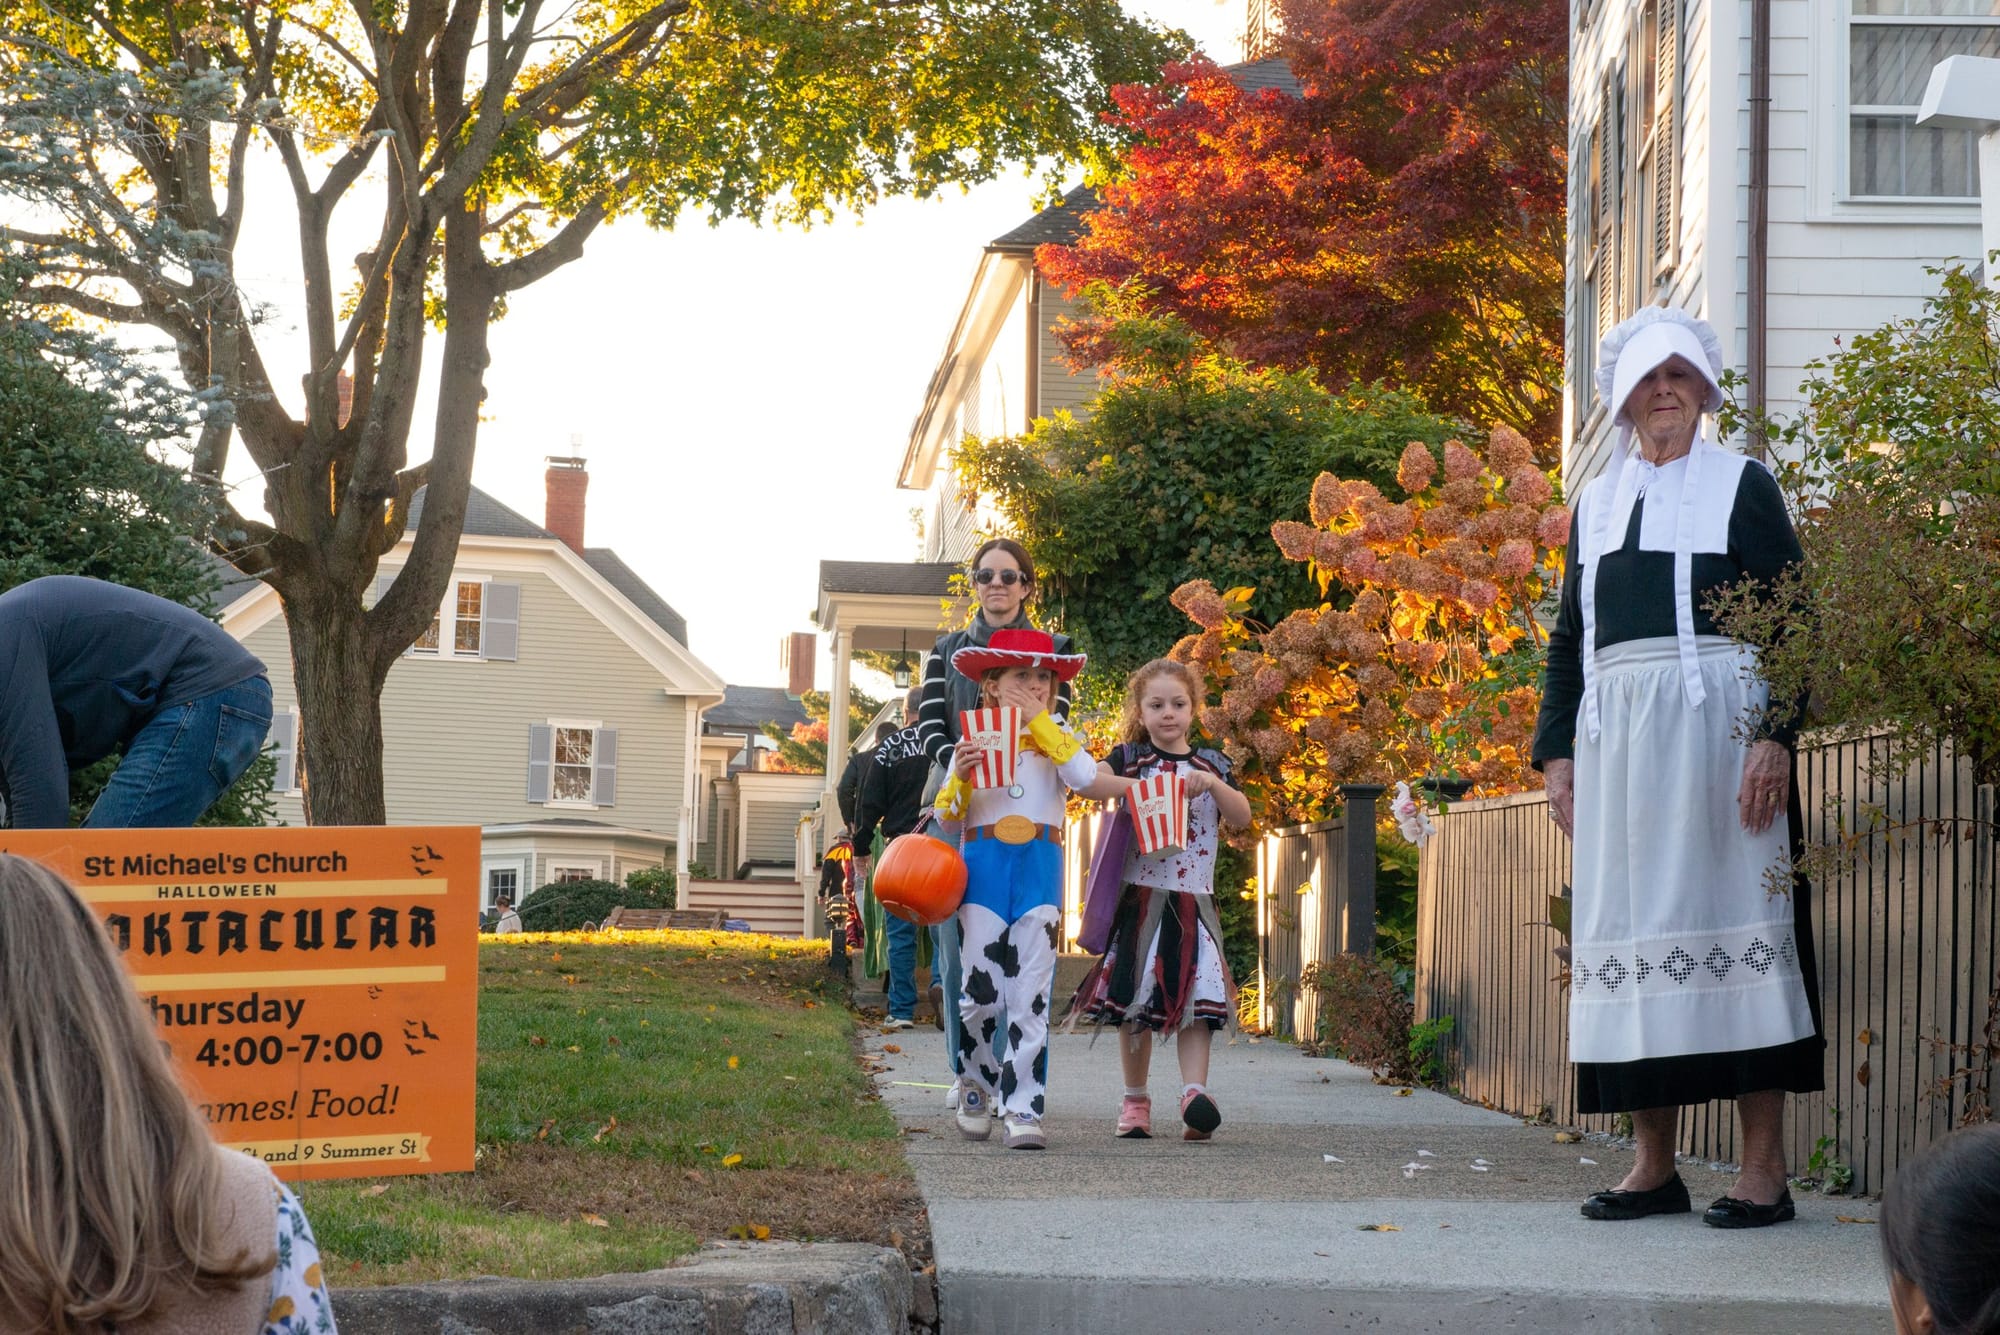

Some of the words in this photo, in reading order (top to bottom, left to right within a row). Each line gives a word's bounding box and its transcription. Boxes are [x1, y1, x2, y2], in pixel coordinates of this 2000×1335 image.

[84, 856, 115, 877] St
[122, 852, 247, 876] Michael's
[253, 851, 347, 874] Church
[157, 884, 276, 899] HALLOWEEN
[104, 905, 436, 957] OKTACULAR
[143, 992, 305, 1030] hursday
[196, 1032, 383, 1067] 4:00-7:00
[198, 1090, 298, 1123] ames!
[306, 1084, 399, 1118] Food!
[264, 1144, 298, 1163] and
[303, 1146, 315, 1160] 9
[321, 1143, 394, 1159] Summer
[400, 1138, 416, 1155] St
